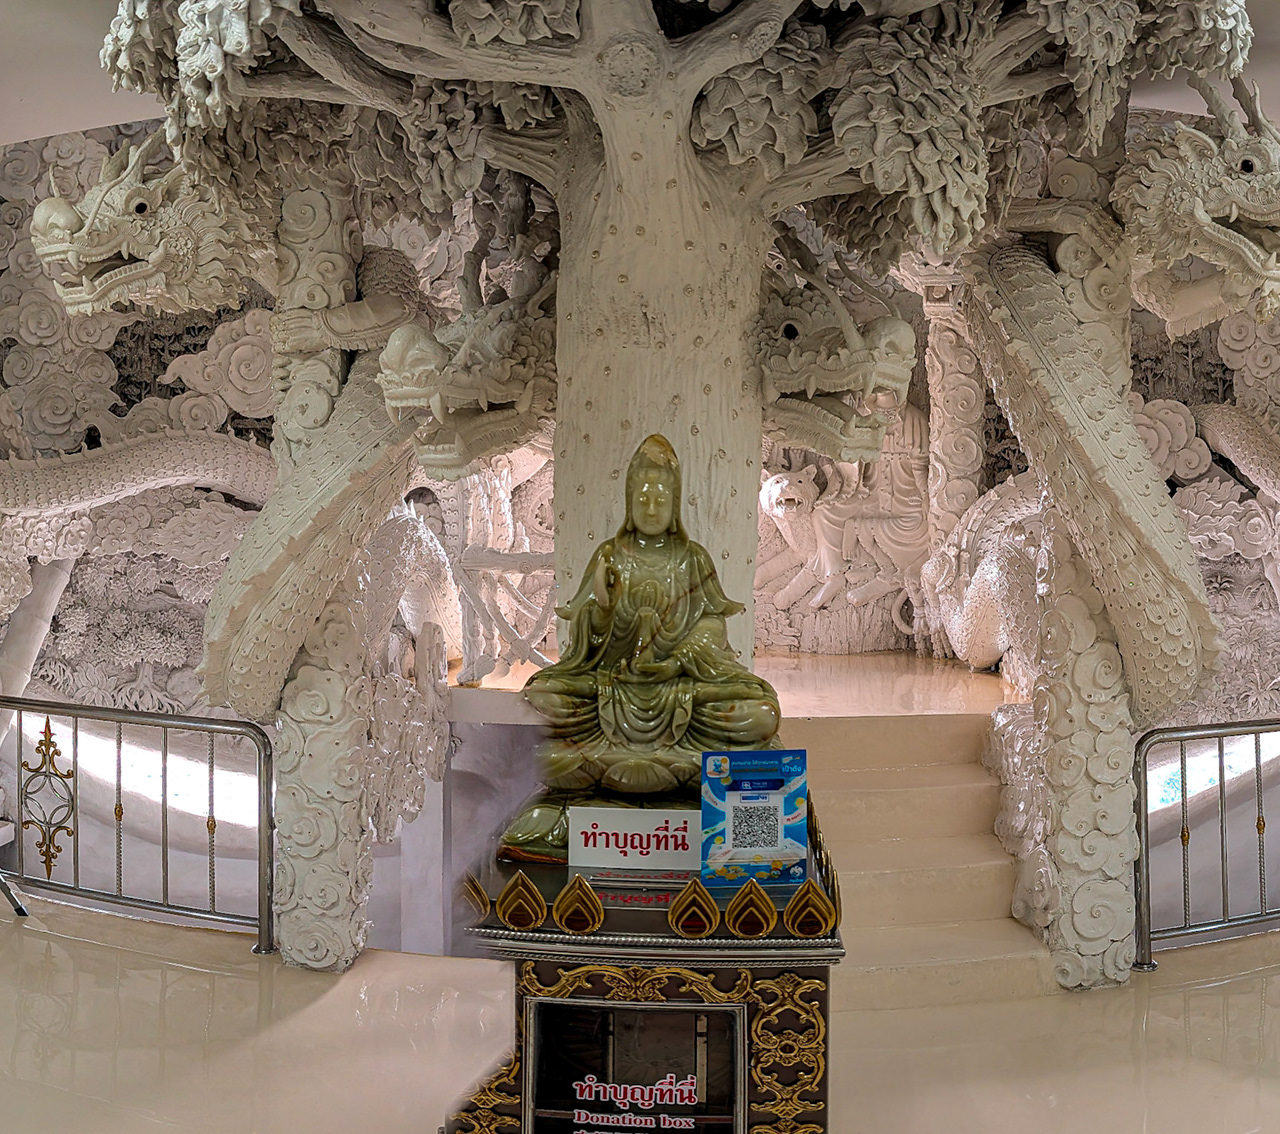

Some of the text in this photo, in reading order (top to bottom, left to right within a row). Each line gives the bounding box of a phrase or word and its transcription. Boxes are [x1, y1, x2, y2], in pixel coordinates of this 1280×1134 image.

[580, 819, 690, 857] ทำบุญที่นี่
[573, 1074, 698, 1109] ทำบุญที่นี่
[573, 1109, 695, 1129] Donation box
